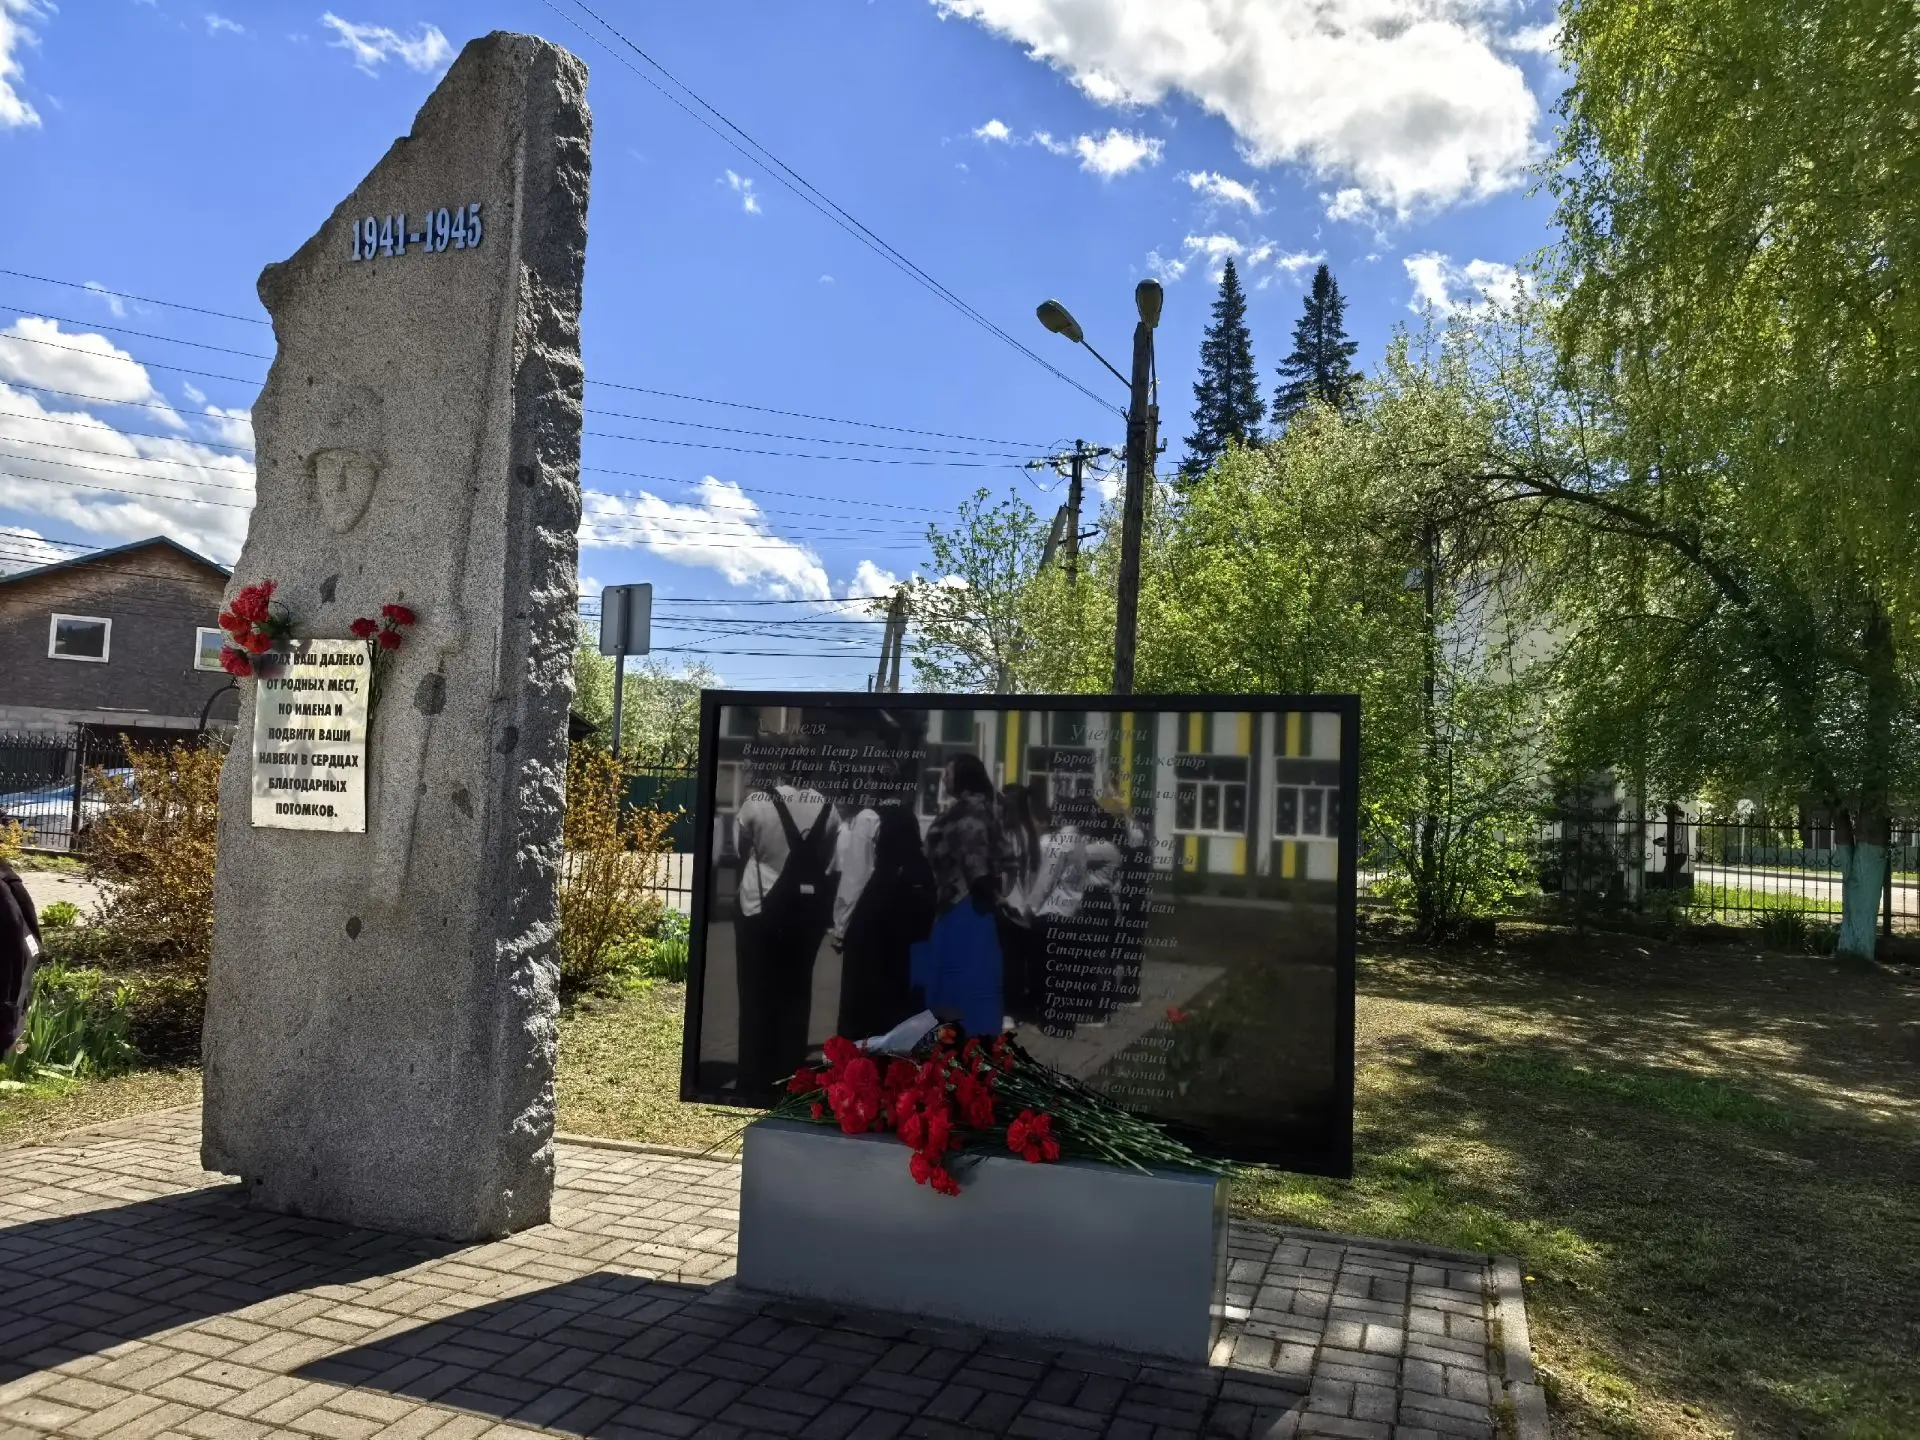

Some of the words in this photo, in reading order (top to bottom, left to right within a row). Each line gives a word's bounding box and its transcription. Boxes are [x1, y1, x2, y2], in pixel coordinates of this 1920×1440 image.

[352, 202, 482, 261] 1941-1945
[293, 653, 317, 666] ВАШ
[319, 653, 364, 667] ДАЛЕКО
[266, 679, 278, 690] ОТ
[280, 679, 325, 692] РОДНЫХ
[327, 679, 359, 694] МЕСТ,
[278, 703, 293, 715] НО
[294, 703, 331, 716] ИМЕНА
[334, 704, 343, 716] И
[268, 728, 316, 742] ПОДВИГИ
[318, 728, 351, 741] ВАШИ
[742, 743, 817, 759] Виноградов
[820, 744, 858, 759] Петр
[862, 745, 928, 759] Павлович
[259, 752, 298, 766] НАВЕКИ
[301, 753, 308, 766] В
[311, 754, 359, 768] СЕРДЦАХ
[790, 759, 823, 771] Иван
[828, 760, 885, 775] Кузьмич
[268, 777, 347, 793] БЛАГОДАРНЫХ
[791, 776, 849, 790] Николай
[275, 802, 338, 818] ПОТОМКОВ.
[1112, 834, 1176, 851] Ниифор
[1047, 895, 1129, 911] Меношин
[1139, 900, 1176, 915] Иван
[1113, 915, 1151, 929] Иван
[1046, 928, 1110, 943] Потехин
[1114, 932, 1179, 948] Николай
[1046, 943, 1107, 959] Старцев
[1110, 947, 1146, 961] Иван
[1045, 976, 1098, 992] Сырцов
[1044, 993, 1093, 1009] Трухин
